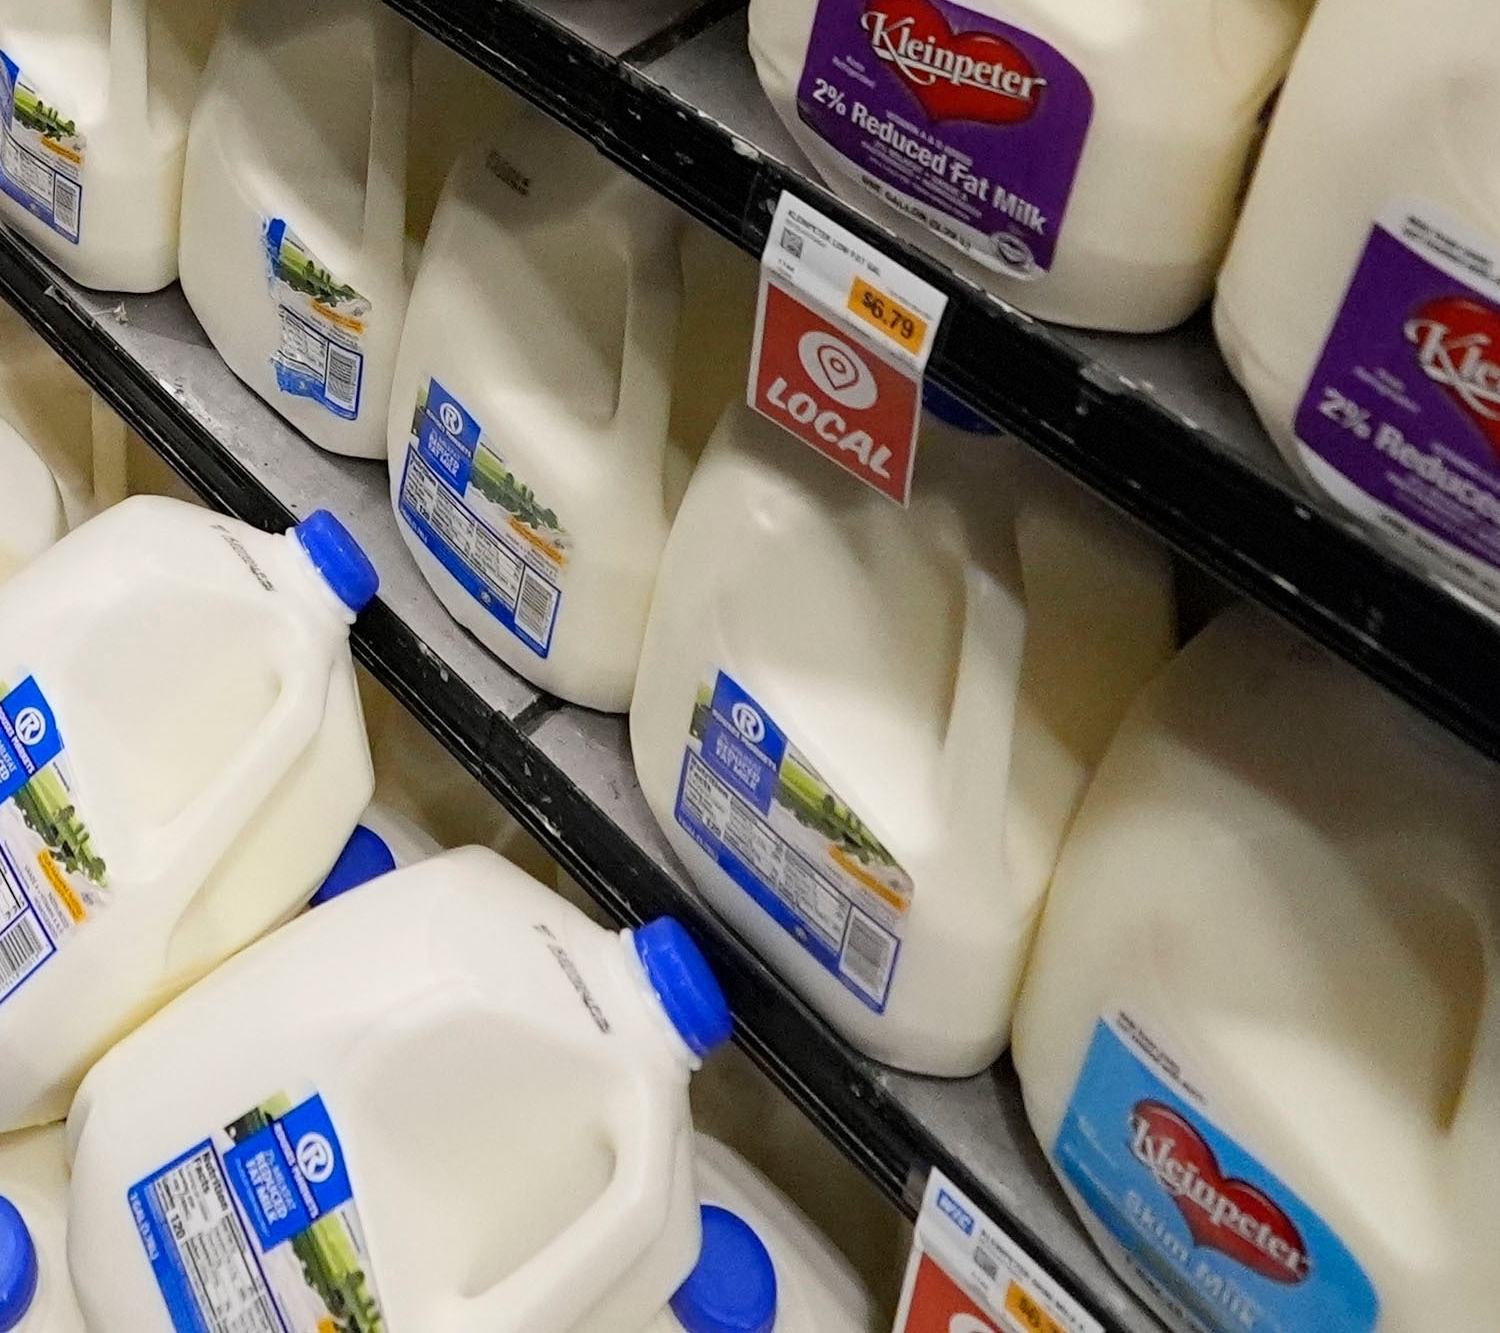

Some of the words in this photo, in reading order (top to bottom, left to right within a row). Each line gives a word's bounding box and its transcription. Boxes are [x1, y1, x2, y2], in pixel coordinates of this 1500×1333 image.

[860, 10, 1048, 100] Kleinpeter
[812, 78, 847, 116] 2%
[851, 102, 948, 177] Reduced
[950, 160, 989, 203] Fat
[994, 185, 1048, 235] Milk
[788, 208, 830, 246] KLEINPETER
[861, 290, 915, 341] $6.79
[766, 377, 893, 480] LOCAL
[1316, 386, 1373, 440] 2%
[202, 1151, 229, 1212] Nutrition
[1128, 1115, 1310, 1276] Kleinpeter
[170, 1213, 187, 1241] 120
[1125, 1190, 1190, 1261] Skim
